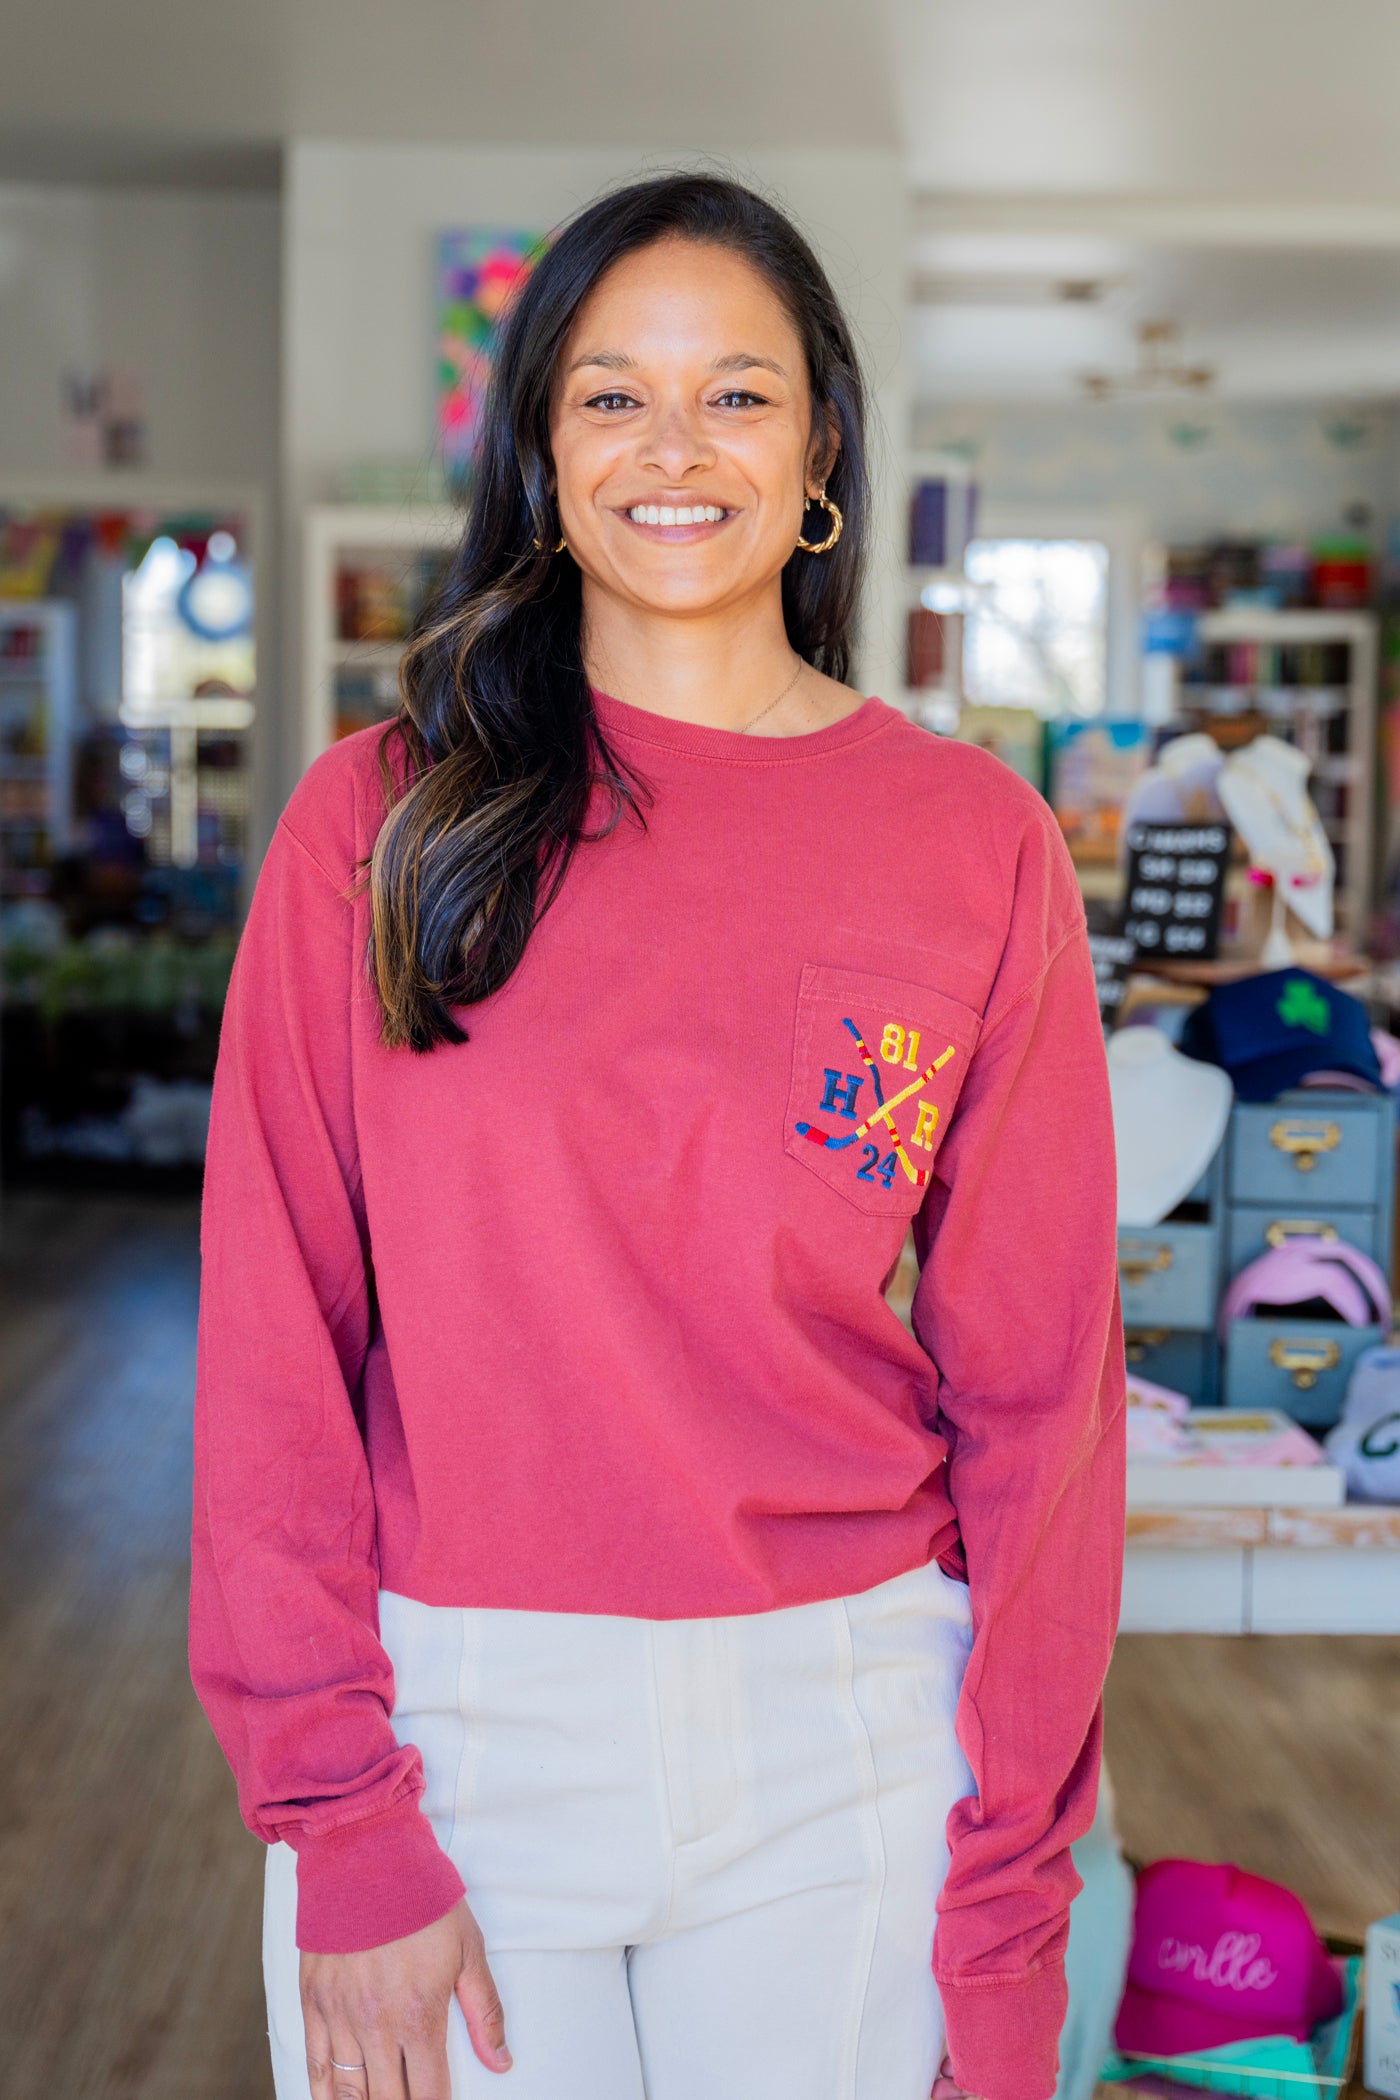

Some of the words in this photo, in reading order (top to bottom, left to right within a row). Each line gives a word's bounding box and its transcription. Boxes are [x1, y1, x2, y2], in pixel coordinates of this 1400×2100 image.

[880, 1023, 920, 1072] 81
[819, 1068, 864, 1120] H
[910, 1099, 939, 1151] R
[856, 1144, 898, 1189] 24
